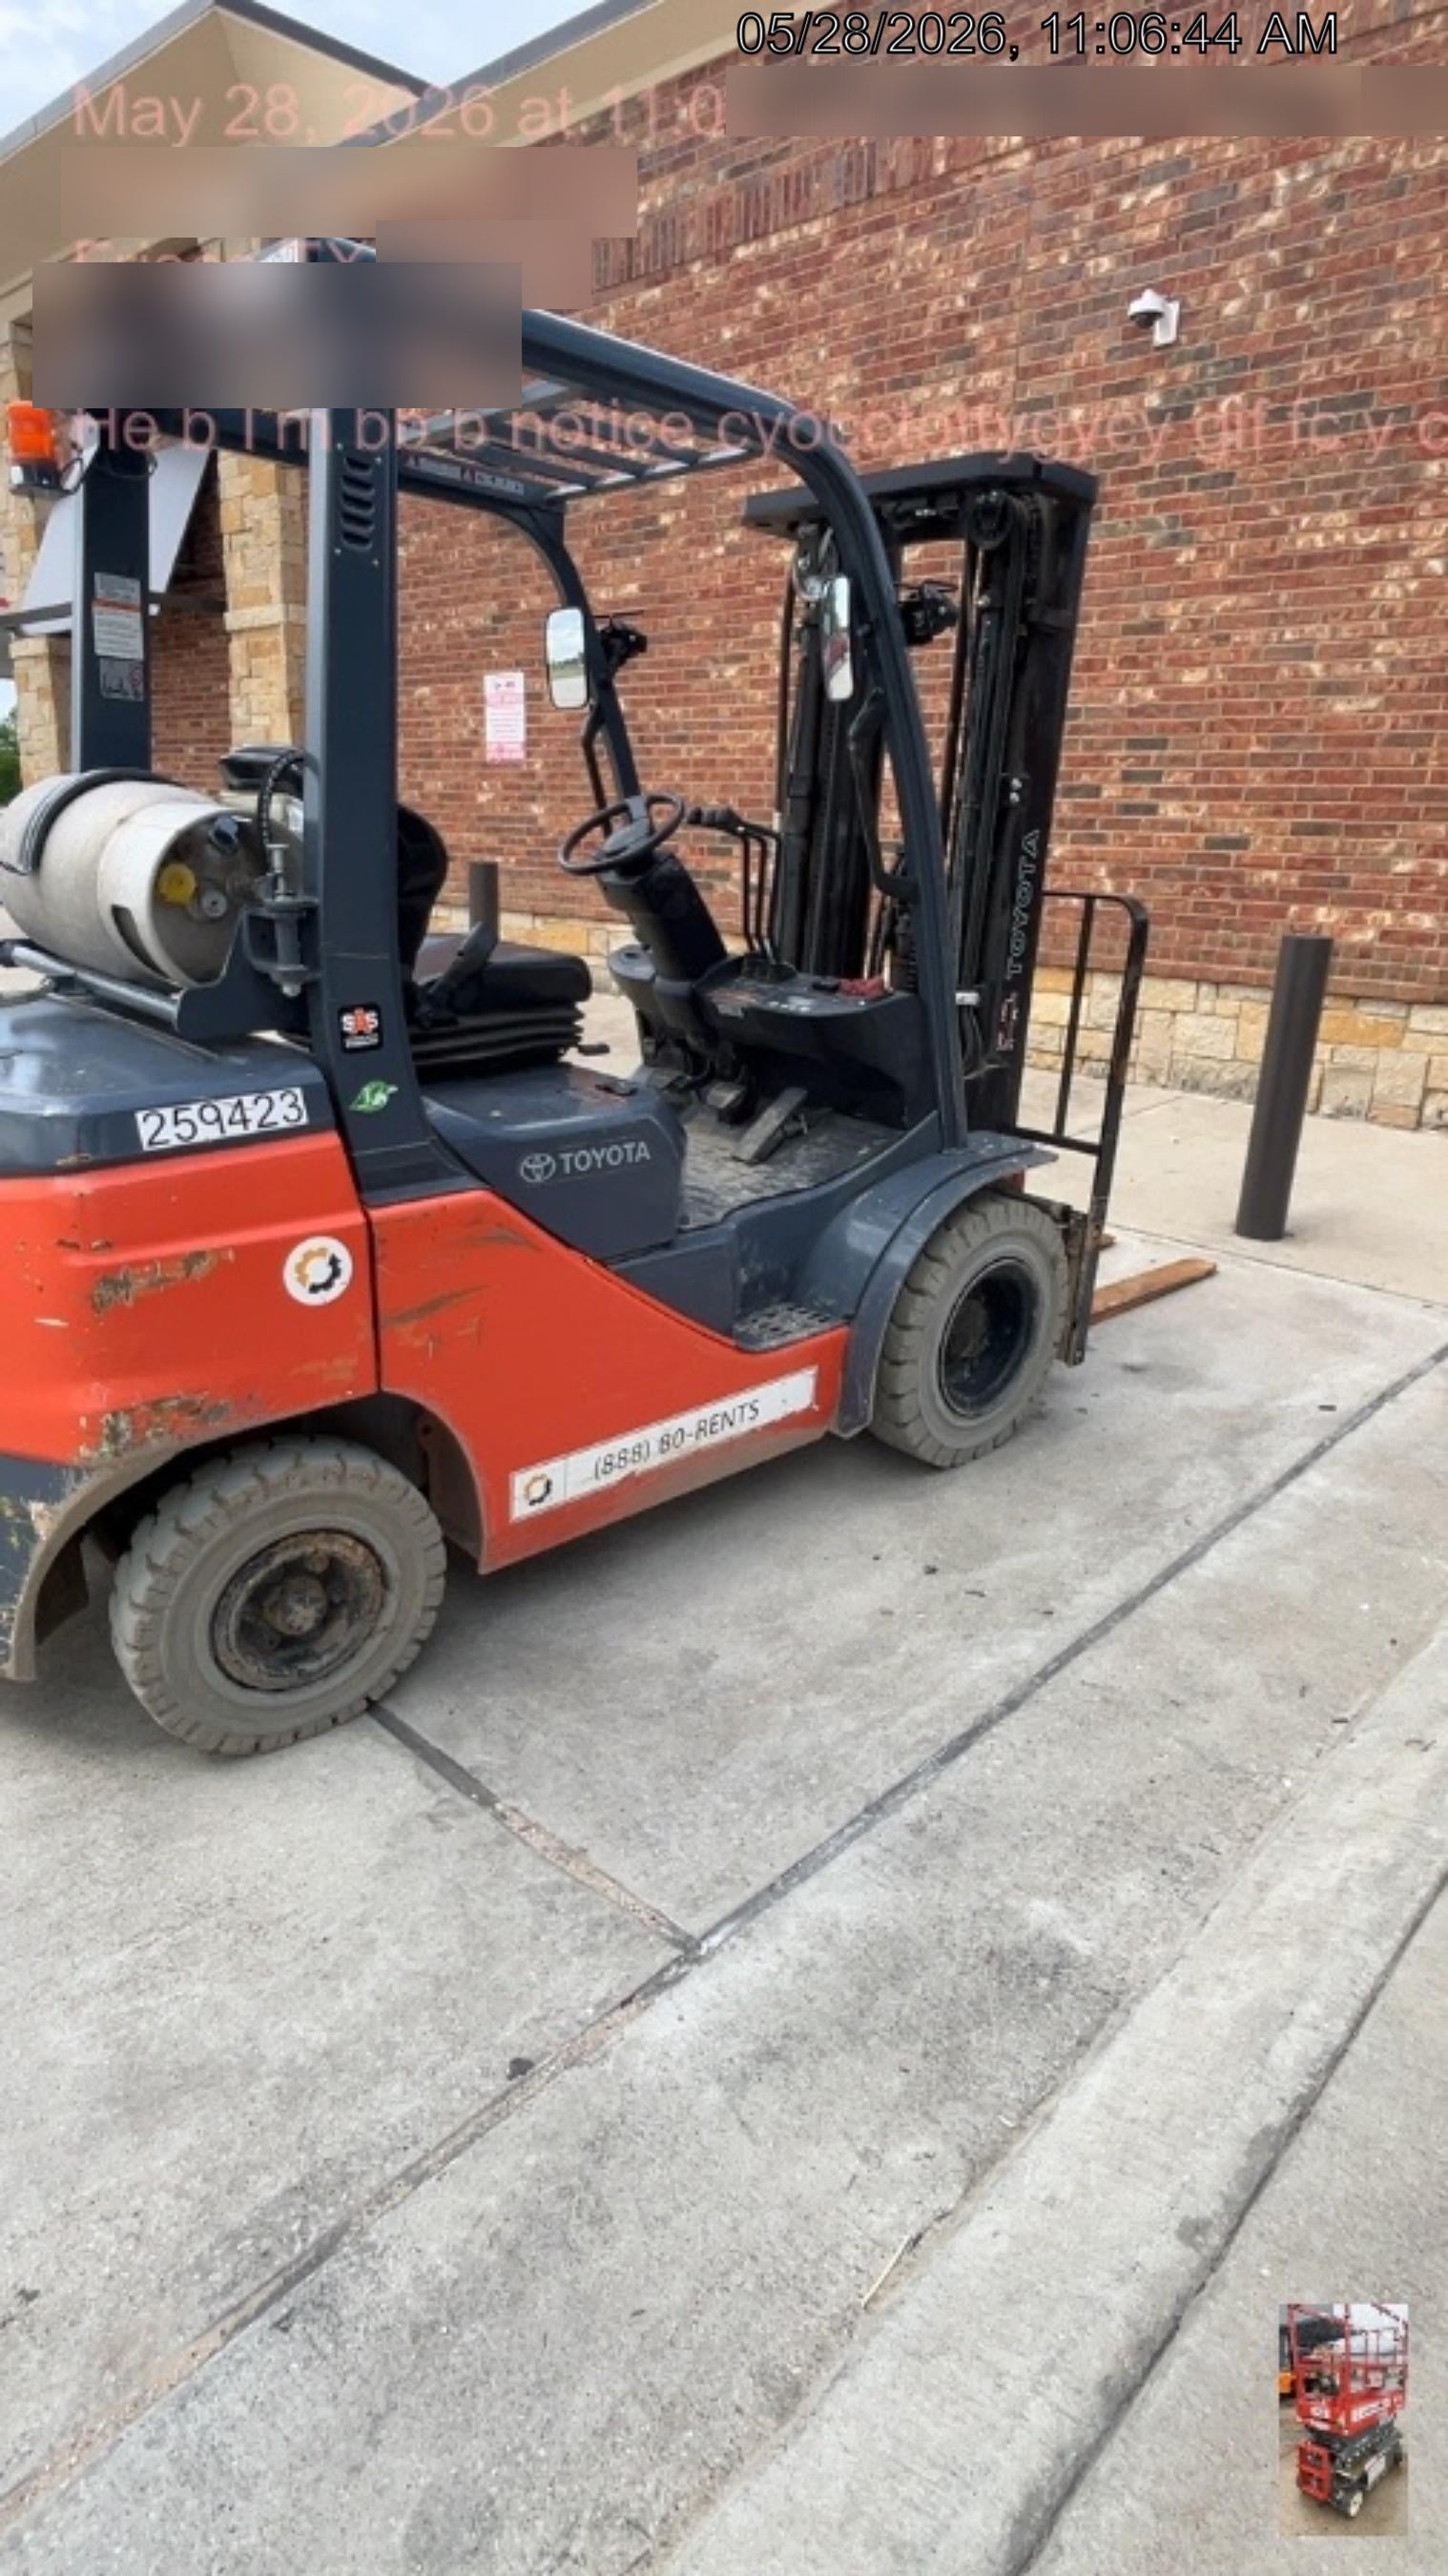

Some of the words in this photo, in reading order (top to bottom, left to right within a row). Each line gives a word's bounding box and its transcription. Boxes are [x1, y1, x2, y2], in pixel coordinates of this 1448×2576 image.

[1005, 829, 1041, 980] TOYOTA
[142, 1089, 304, 1147] 259423
[558, 1141, 651, 1174] TOYOTA
[593, 1439, 652, 1481] (888)
